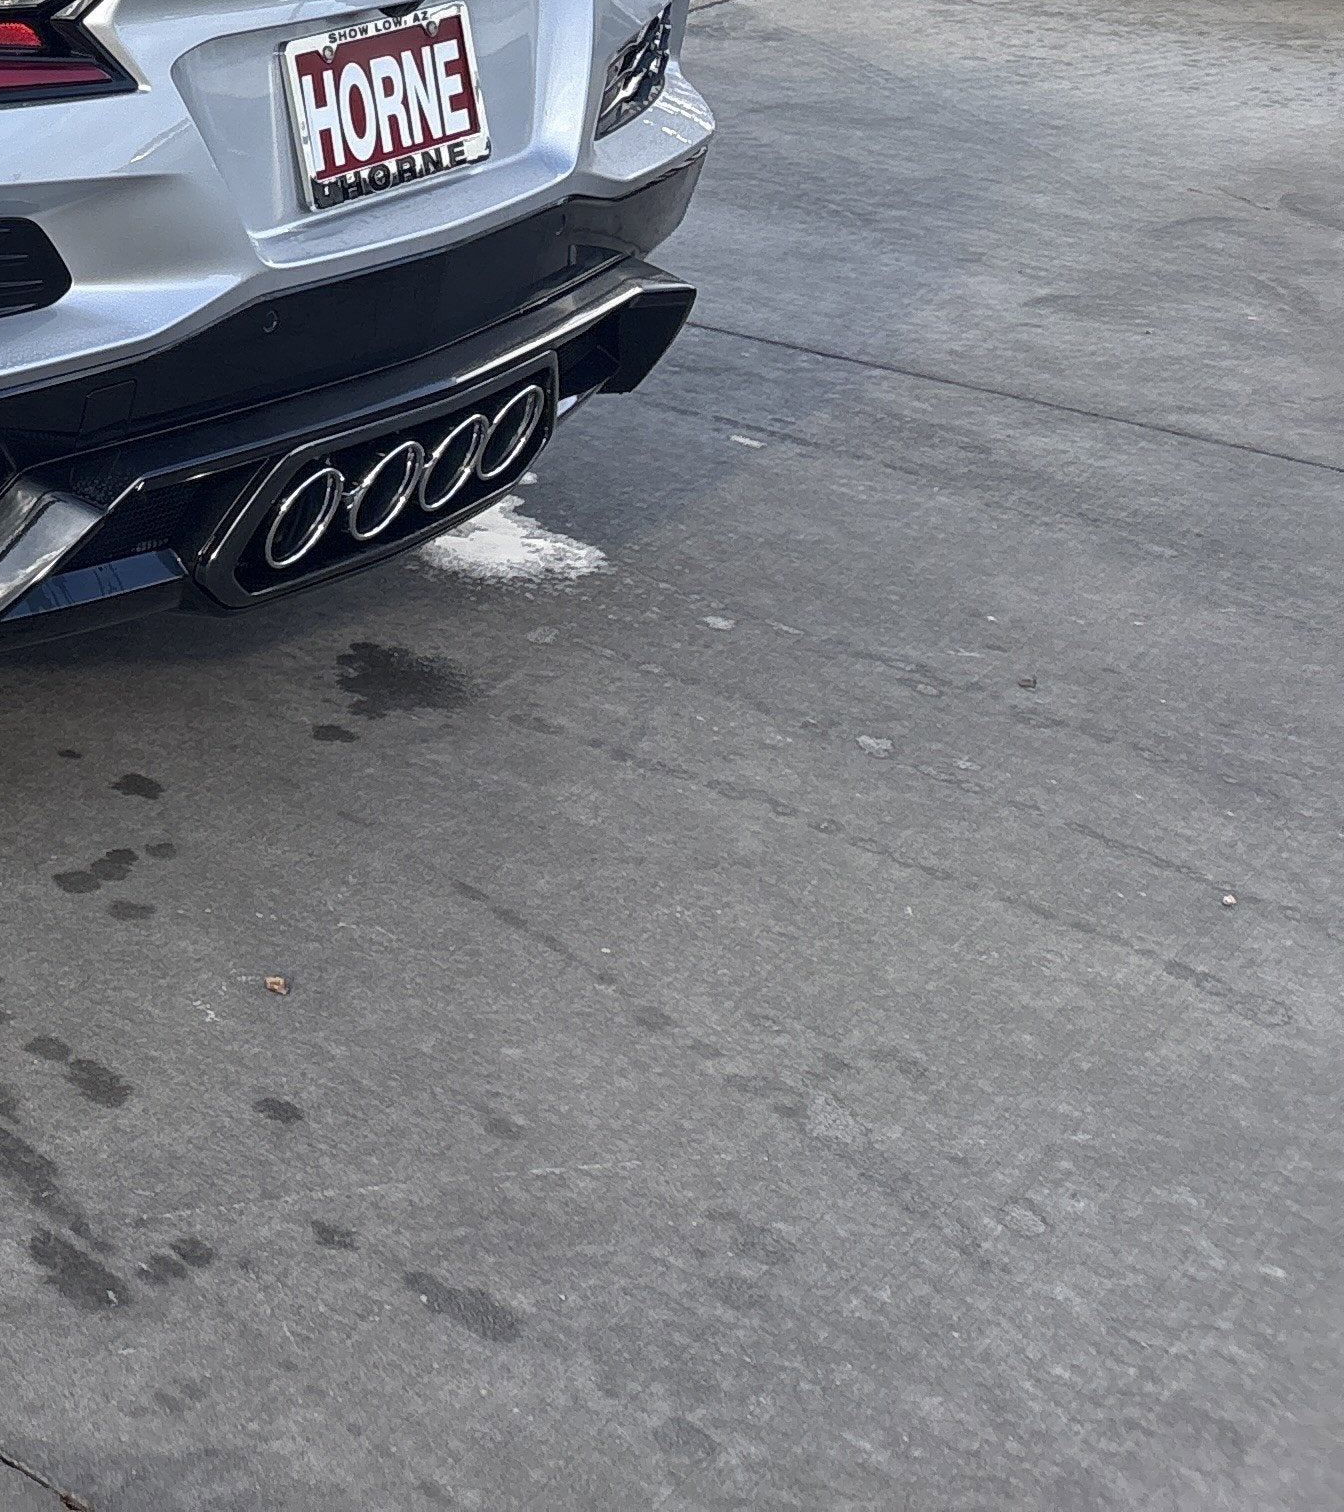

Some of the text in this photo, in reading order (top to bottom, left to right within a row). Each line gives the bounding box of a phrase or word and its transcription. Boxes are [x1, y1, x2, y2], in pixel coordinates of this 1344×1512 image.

[328, 10, 429, 45] SHOW LOW, AZ
[301, 38, 471, 173] HORNE
[341, 141, 468, 200] HORNE
